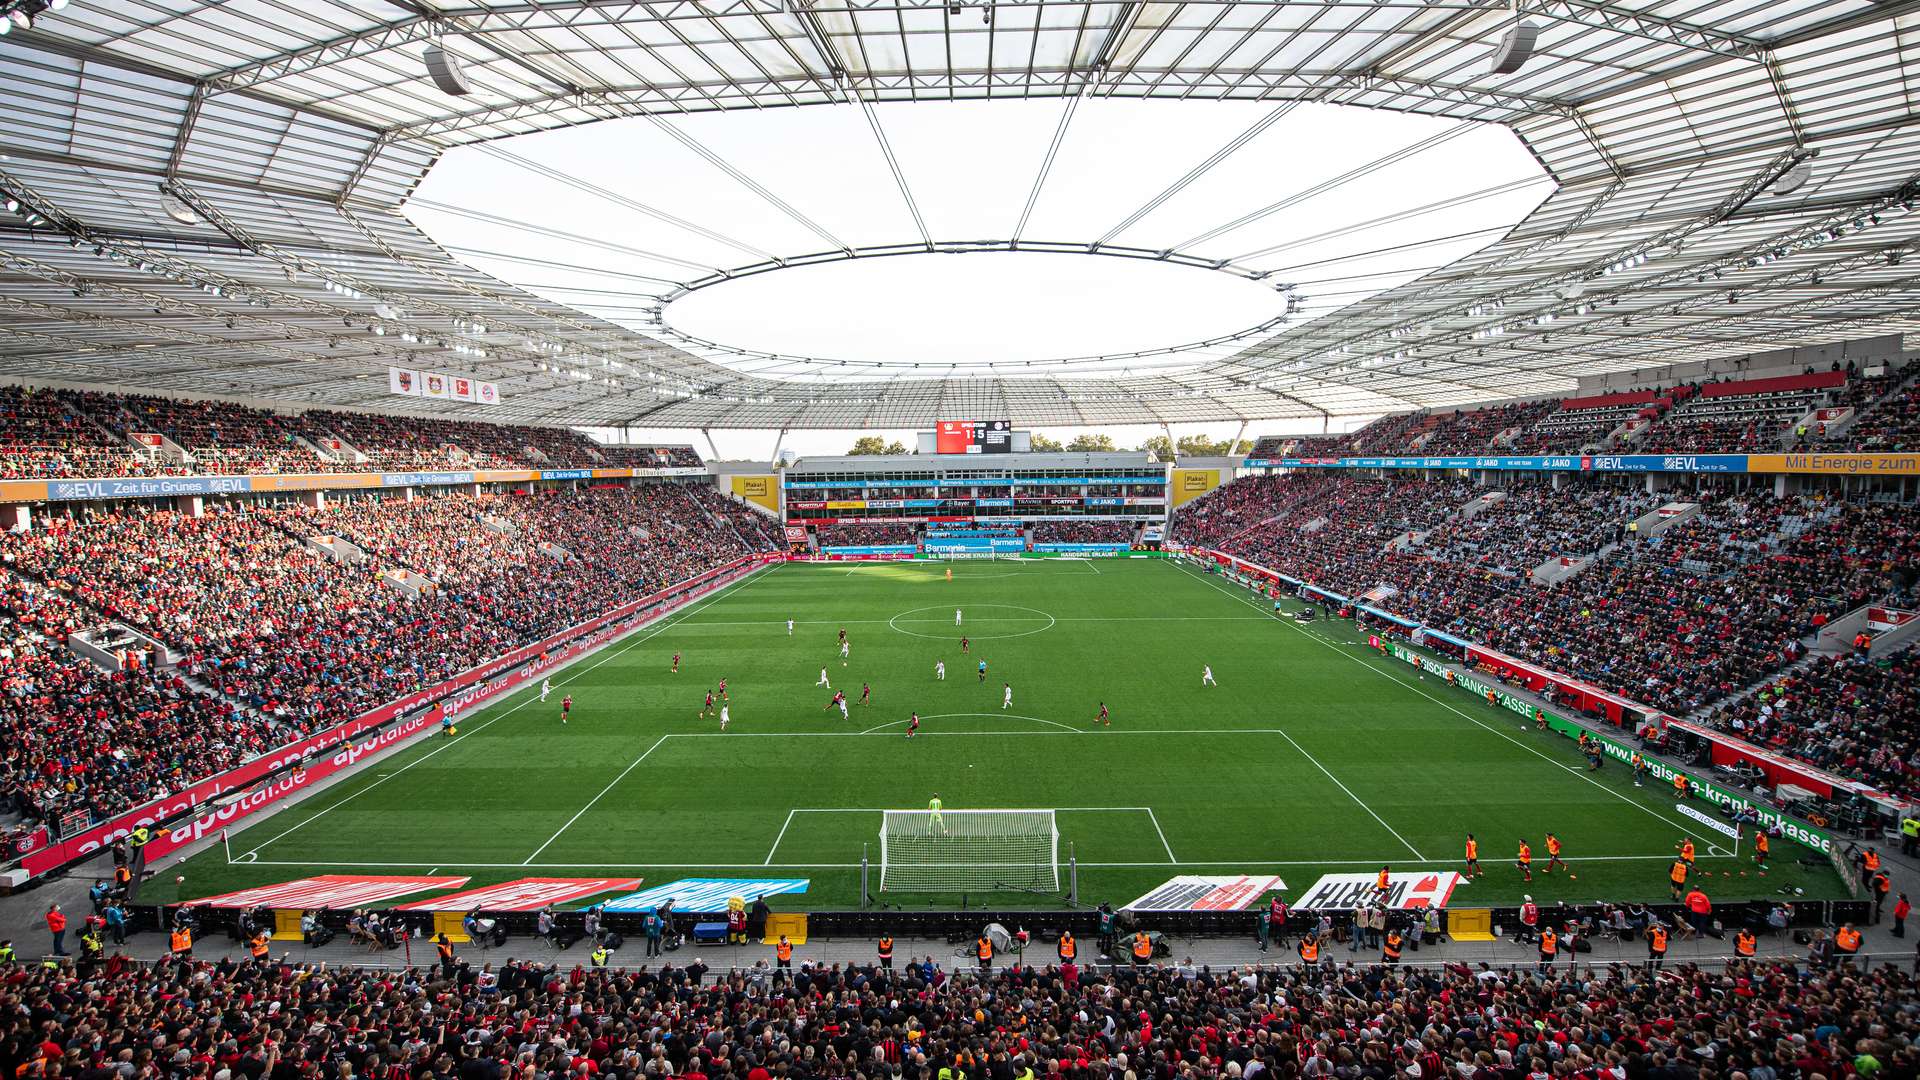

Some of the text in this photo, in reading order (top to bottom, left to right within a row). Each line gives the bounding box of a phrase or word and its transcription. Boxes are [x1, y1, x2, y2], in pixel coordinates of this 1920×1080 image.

[1483, 459, 1498, 467] JAKO
[1551, 459, 1570, 468] JAKO
[1604, 457, 1624, 469] EVL
[1675, 457, 1700, 470] EVL
[1785, 455, 1916, 472] Mit Energie zum
[74, 479, 246, 497] EVL Zeit für Grünes EVL
[393, 475, 408, 485] EVL
[925, 543, 966, 552] Barmenia
[990, 538, 1023, 546] Barmenia
[578, 625, 618, 650] apotal.de
[520, 648, 570, 679] apotal.de
[1406, 648, 1533, 718] BEGISCHE KRANKEKASSE
[442, 676, 509, 714] apotal.de
[333, 714, 426, 767] apotal.de
[1593, 736, 1830, 854] ww.brgise-kranenkasse
[170, 768, 307, 843] apotal.de
